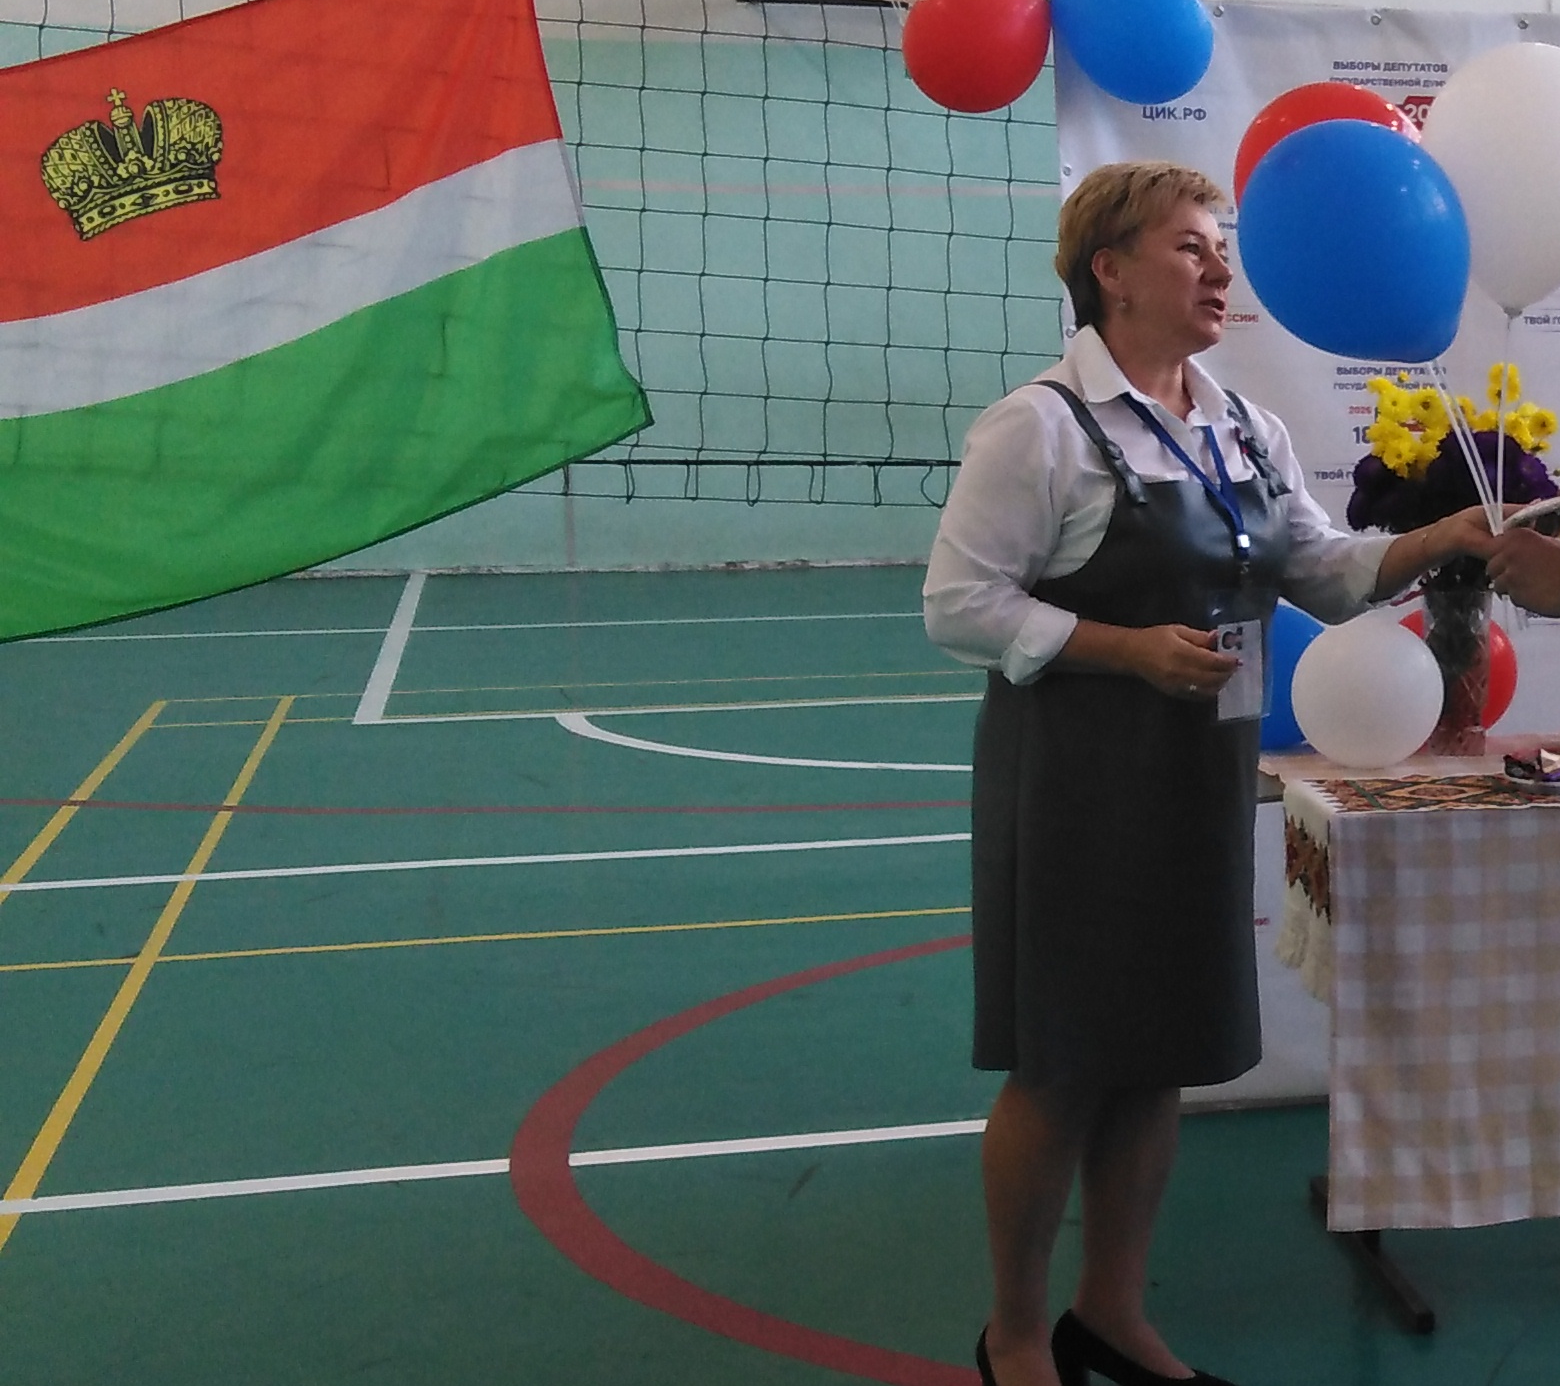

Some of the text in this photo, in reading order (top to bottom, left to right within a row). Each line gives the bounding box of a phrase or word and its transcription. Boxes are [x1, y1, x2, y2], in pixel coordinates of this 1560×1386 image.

[1333, 61, 1448, 73] ВЫБОРЫ ДЕПУТАТОВ
[1142, 106, 1207, 121] ЦИК.РФ
[1524, 314, 1549, 325] ТВОЙ
[1337, 367, 1382, 376] ВЫБОРЫ
[1314, 469, 1343, 480] ТВОЙ
